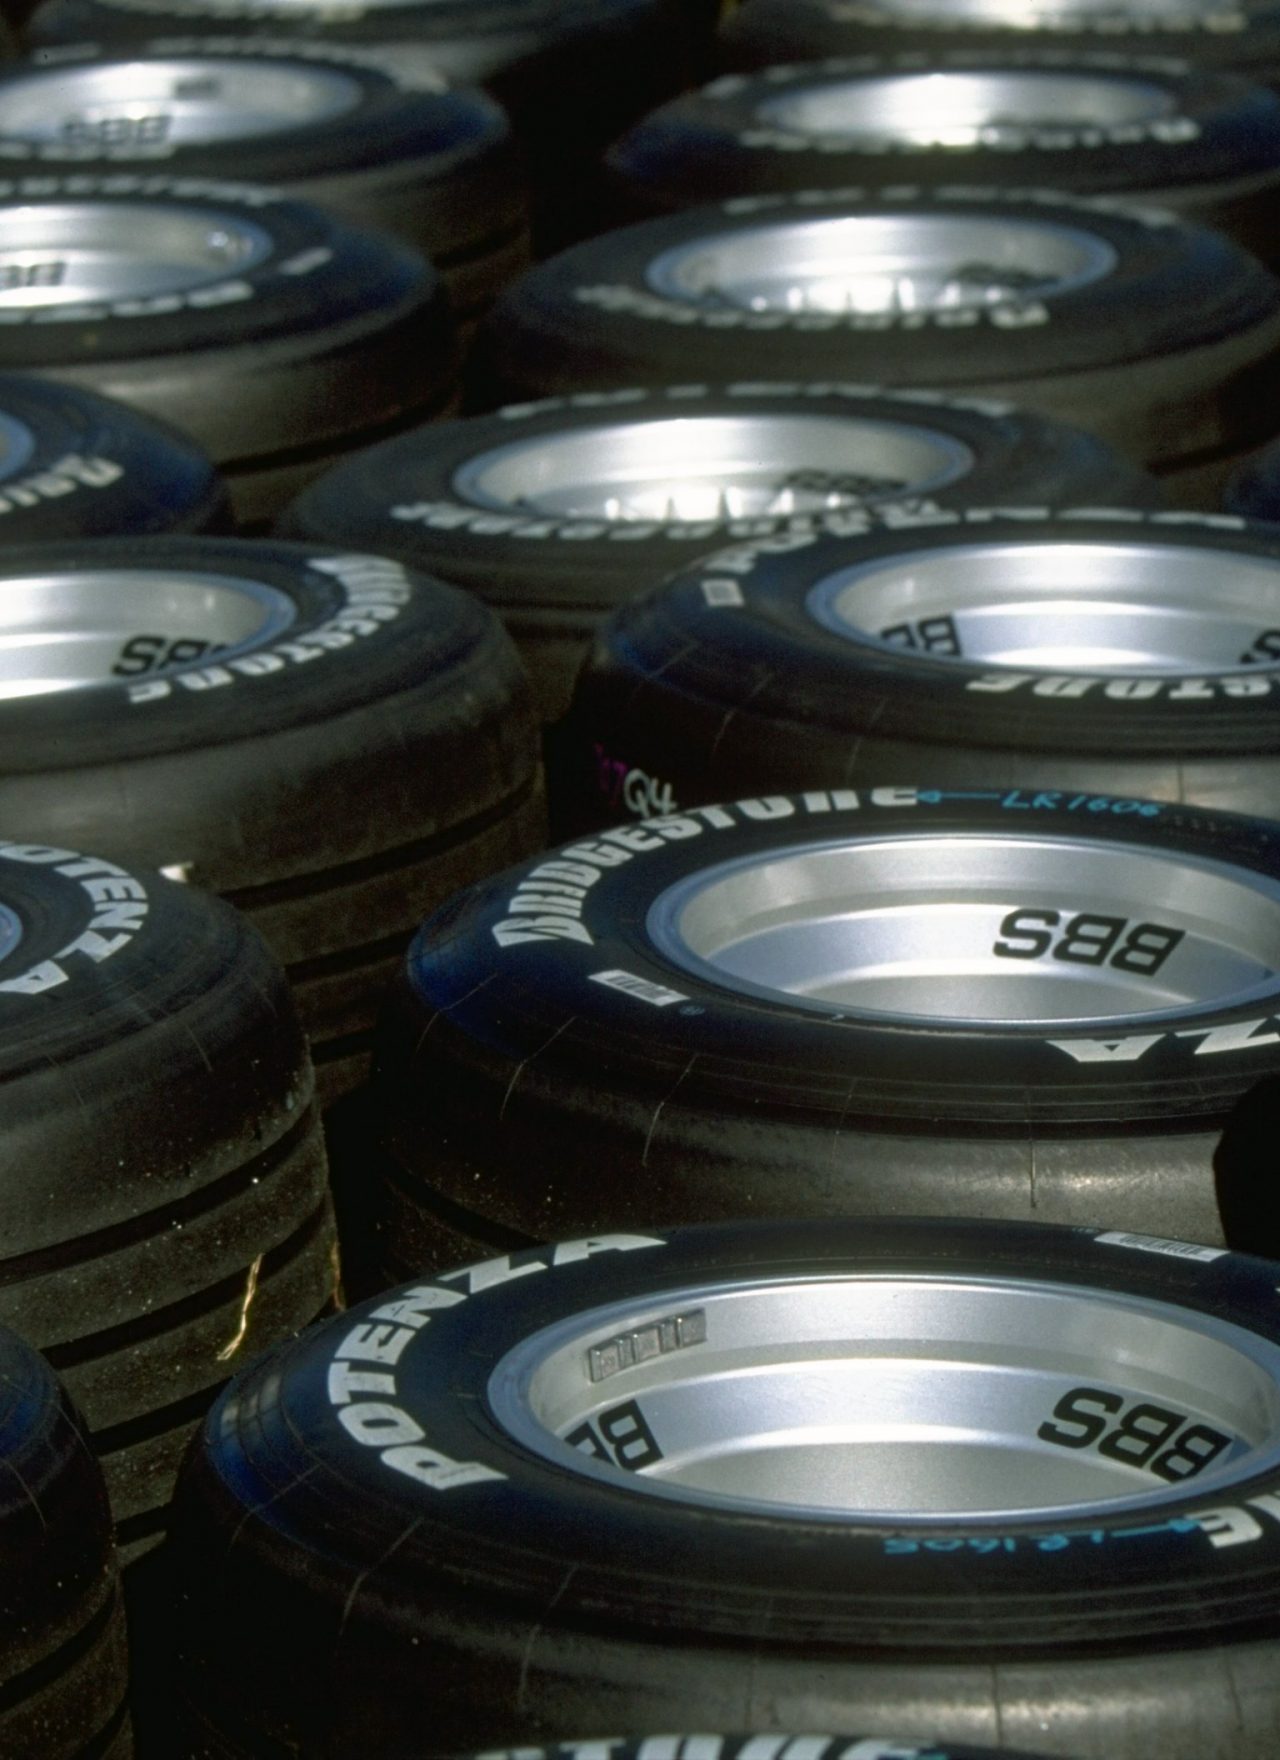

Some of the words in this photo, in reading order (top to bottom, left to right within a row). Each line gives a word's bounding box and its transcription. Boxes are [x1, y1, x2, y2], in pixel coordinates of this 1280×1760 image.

[0, 841, 149, 994] OTENZA
[993, 909, 1185, 977] BBS
[328, 1233, 667, 1491] POTENZA
[1037, 1387, 1233, 1483] BBS
